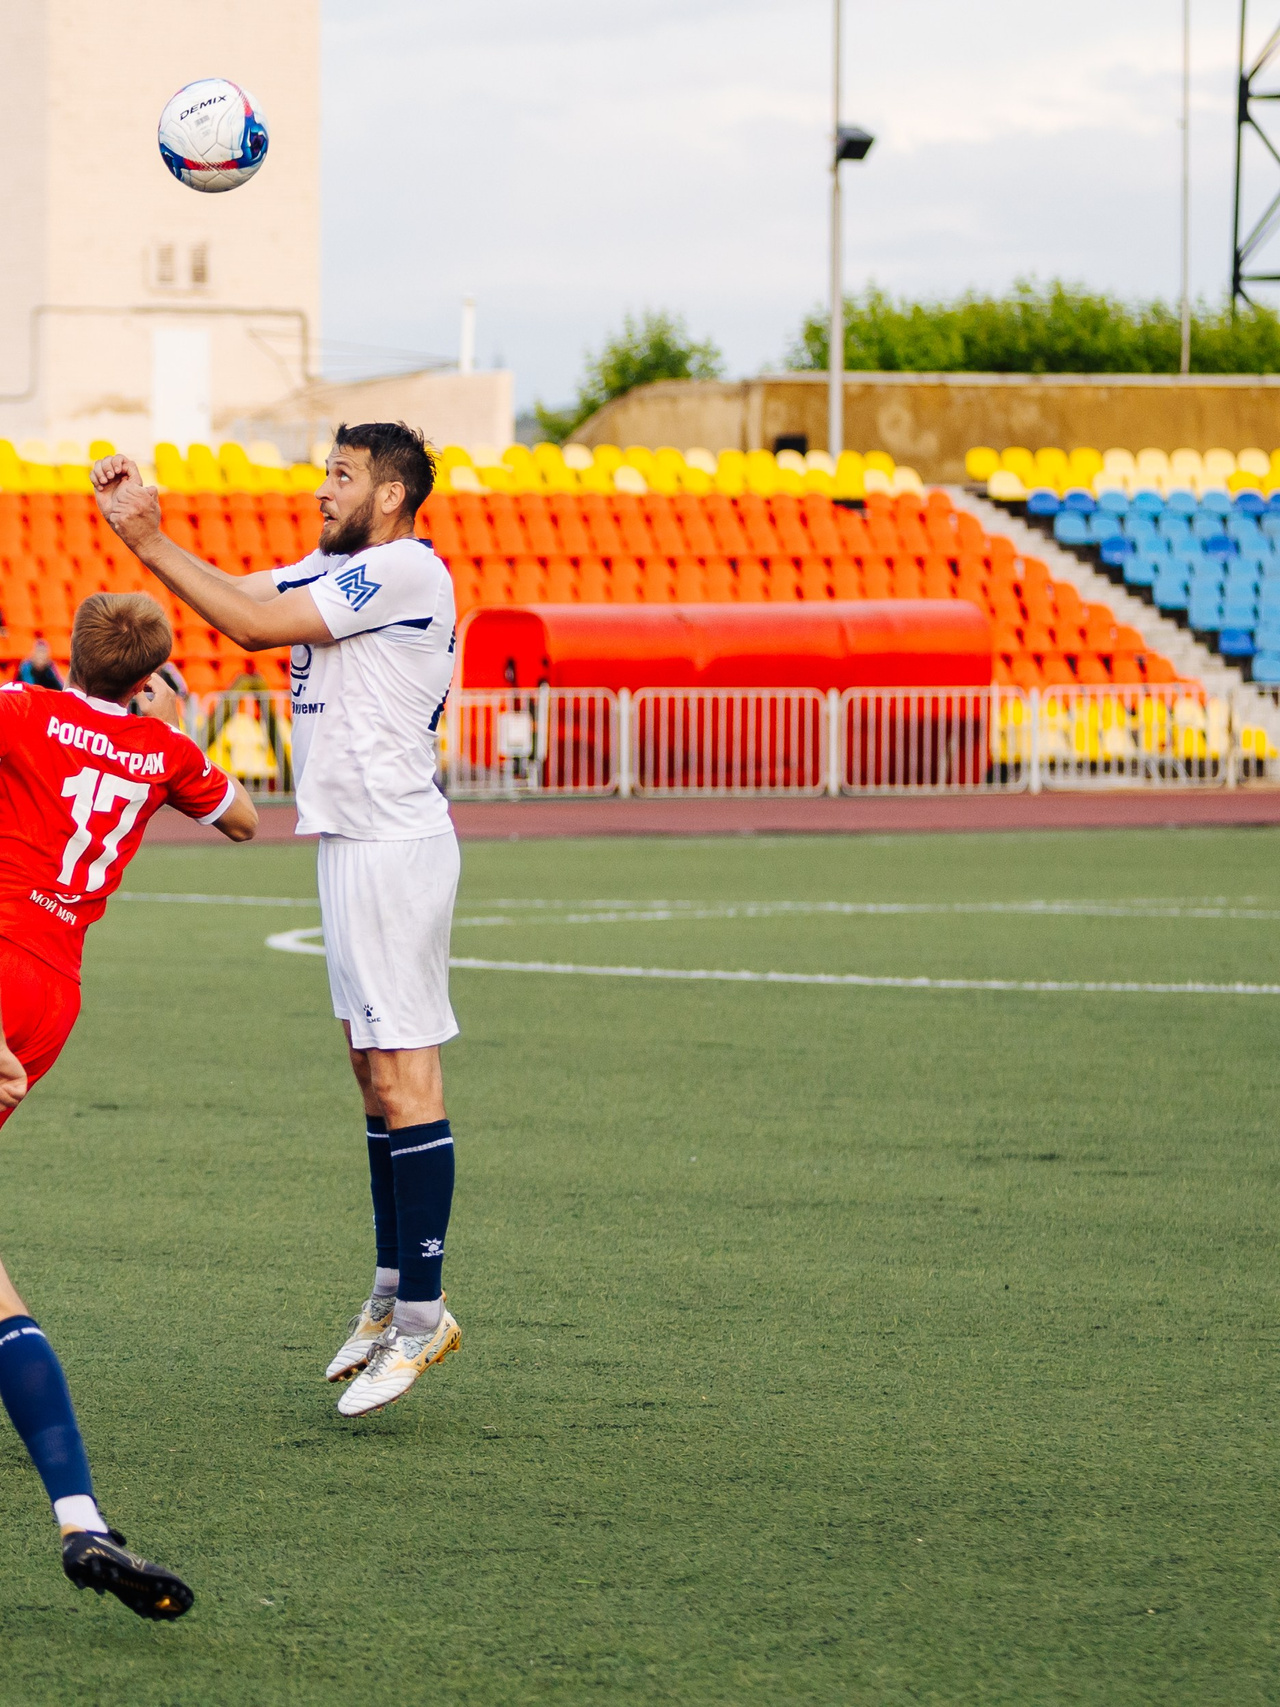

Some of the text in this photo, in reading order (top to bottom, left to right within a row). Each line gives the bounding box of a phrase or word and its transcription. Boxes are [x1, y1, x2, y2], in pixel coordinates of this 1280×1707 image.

[179, 95, 227, 120] DEMIX
[57, 766, 151, 893] 17
[29, 889, 77, 926] МОЙ МЯЧ
